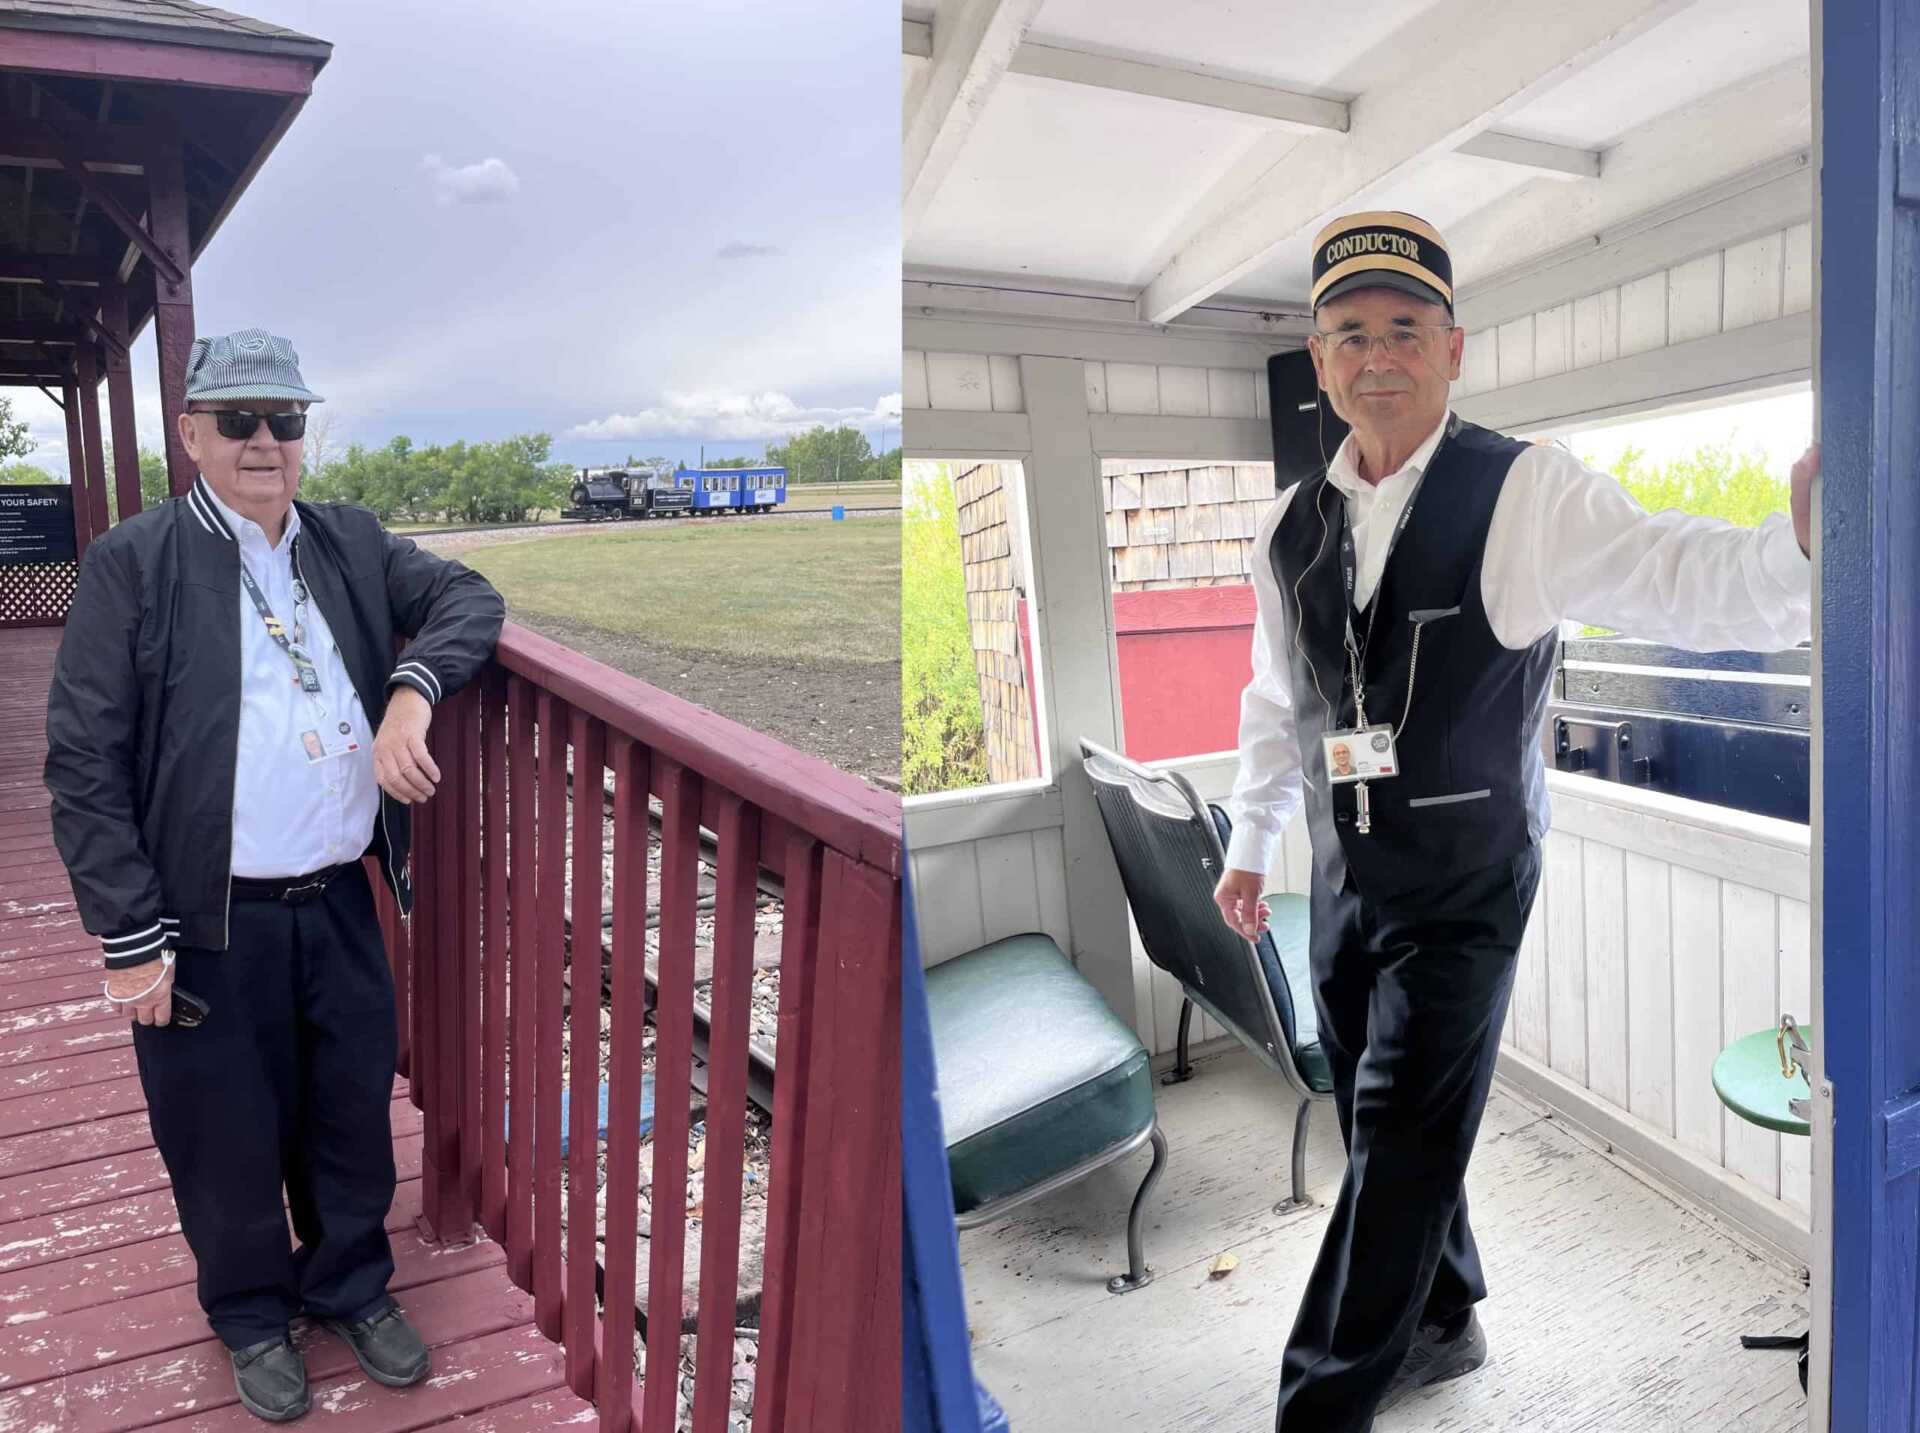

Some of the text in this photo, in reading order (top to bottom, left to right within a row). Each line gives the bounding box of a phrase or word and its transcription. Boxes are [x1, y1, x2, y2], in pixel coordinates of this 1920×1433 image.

[1326, 233, 1420, 264] CONDUCTOR
[1, 498, 58, 506] YOUR SAFETY
